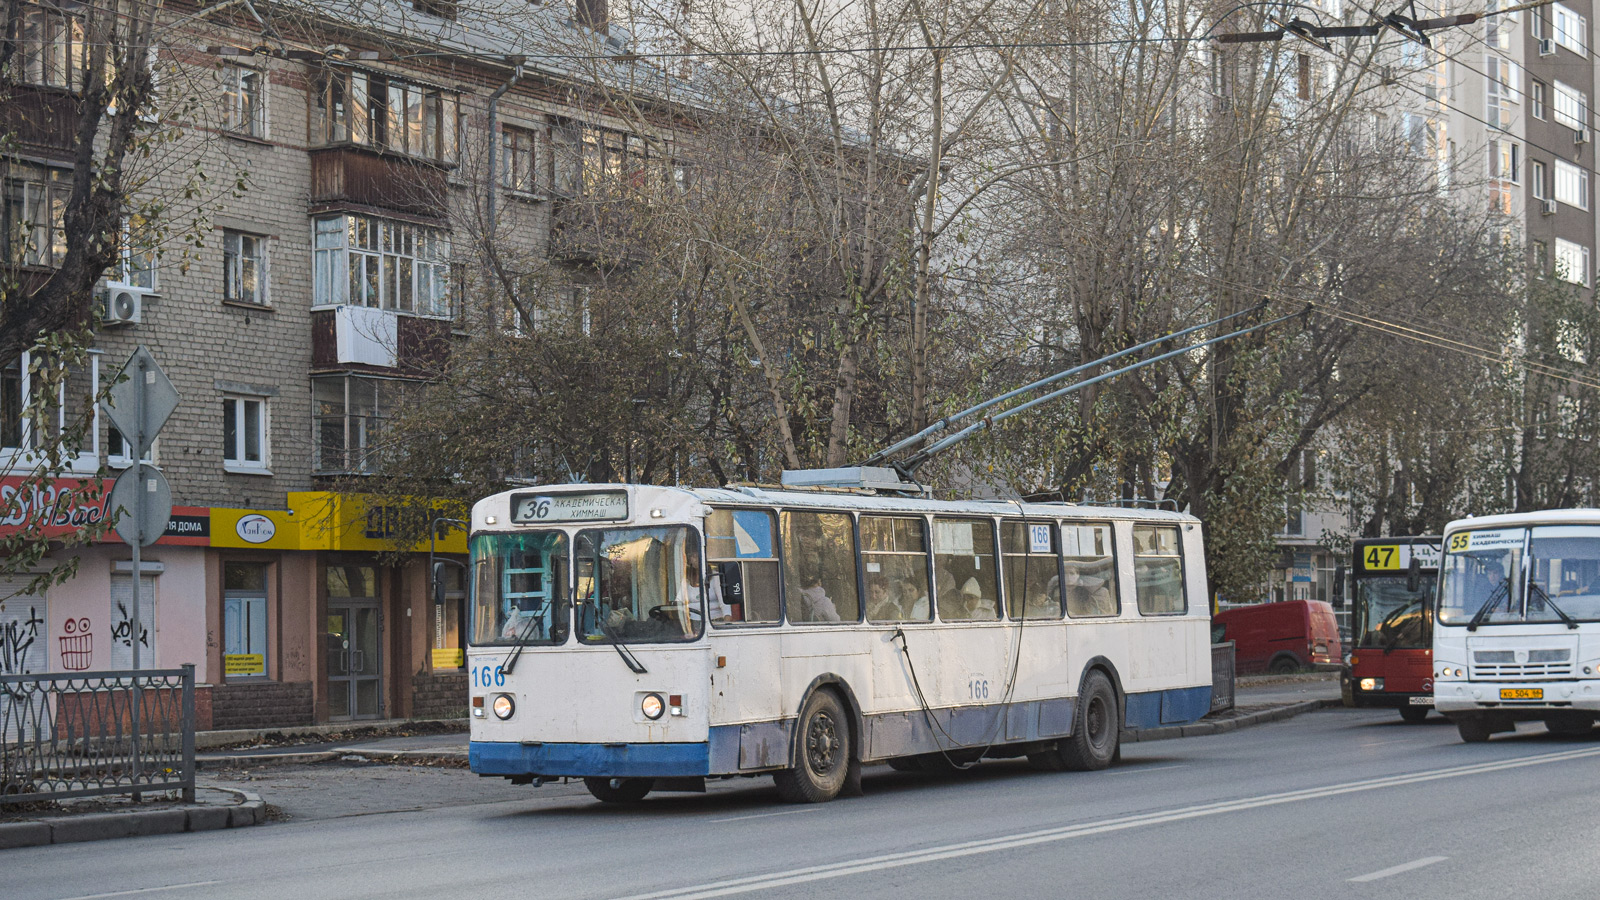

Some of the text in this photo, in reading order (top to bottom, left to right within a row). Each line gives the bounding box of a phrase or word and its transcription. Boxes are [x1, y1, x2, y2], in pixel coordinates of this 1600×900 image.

[523, 500, 551, 519] 36
[554, 497, 627, 508] АКАДЕМИЧЕСКАЯ
[570, 509, 607, 518] ХИММАШ
[178, 521, 203, 532] ДОМА
[1032, 525, 1049, 544] 166
[1451, 535, 1468, 549] 55
[1366, 547, 1395, 567] 47
[733, 582, 741, 595] 166
[472, 665, 505, 687] 166
[968, 680, 989, 699] 166
[1515, 689, 1529, 698] 504
